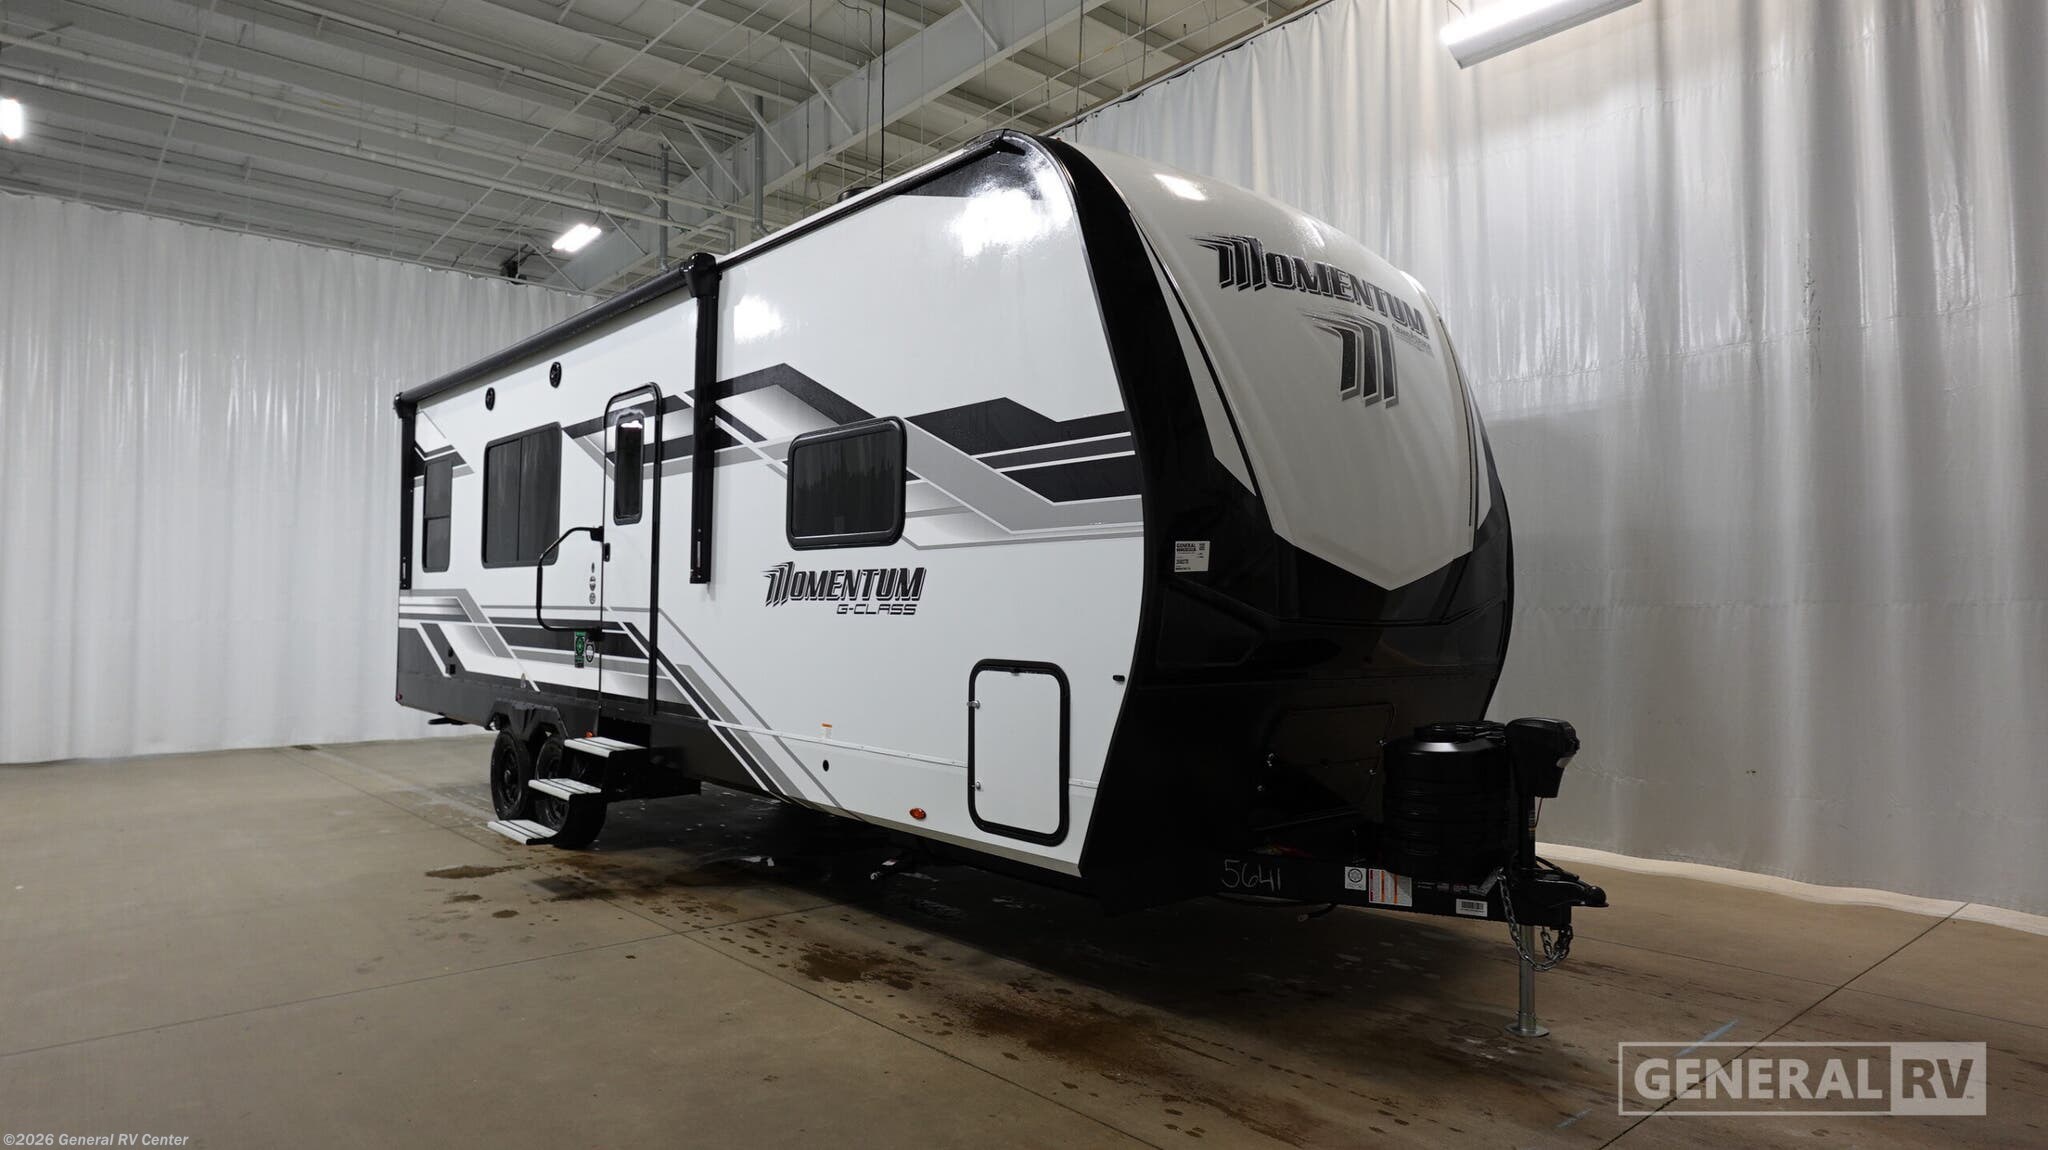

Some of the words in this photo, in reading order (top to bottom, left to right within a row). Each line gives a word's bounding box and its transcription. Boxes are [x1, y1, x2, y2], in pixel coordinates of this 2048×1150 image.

[1188, 231, 1430, 339] MOMENTUM
[763, 561, 927, 607] MOMENTUM
[836, 603, 918, 615] G-CLASS
[1221, 859, 1281, 892] 5641
